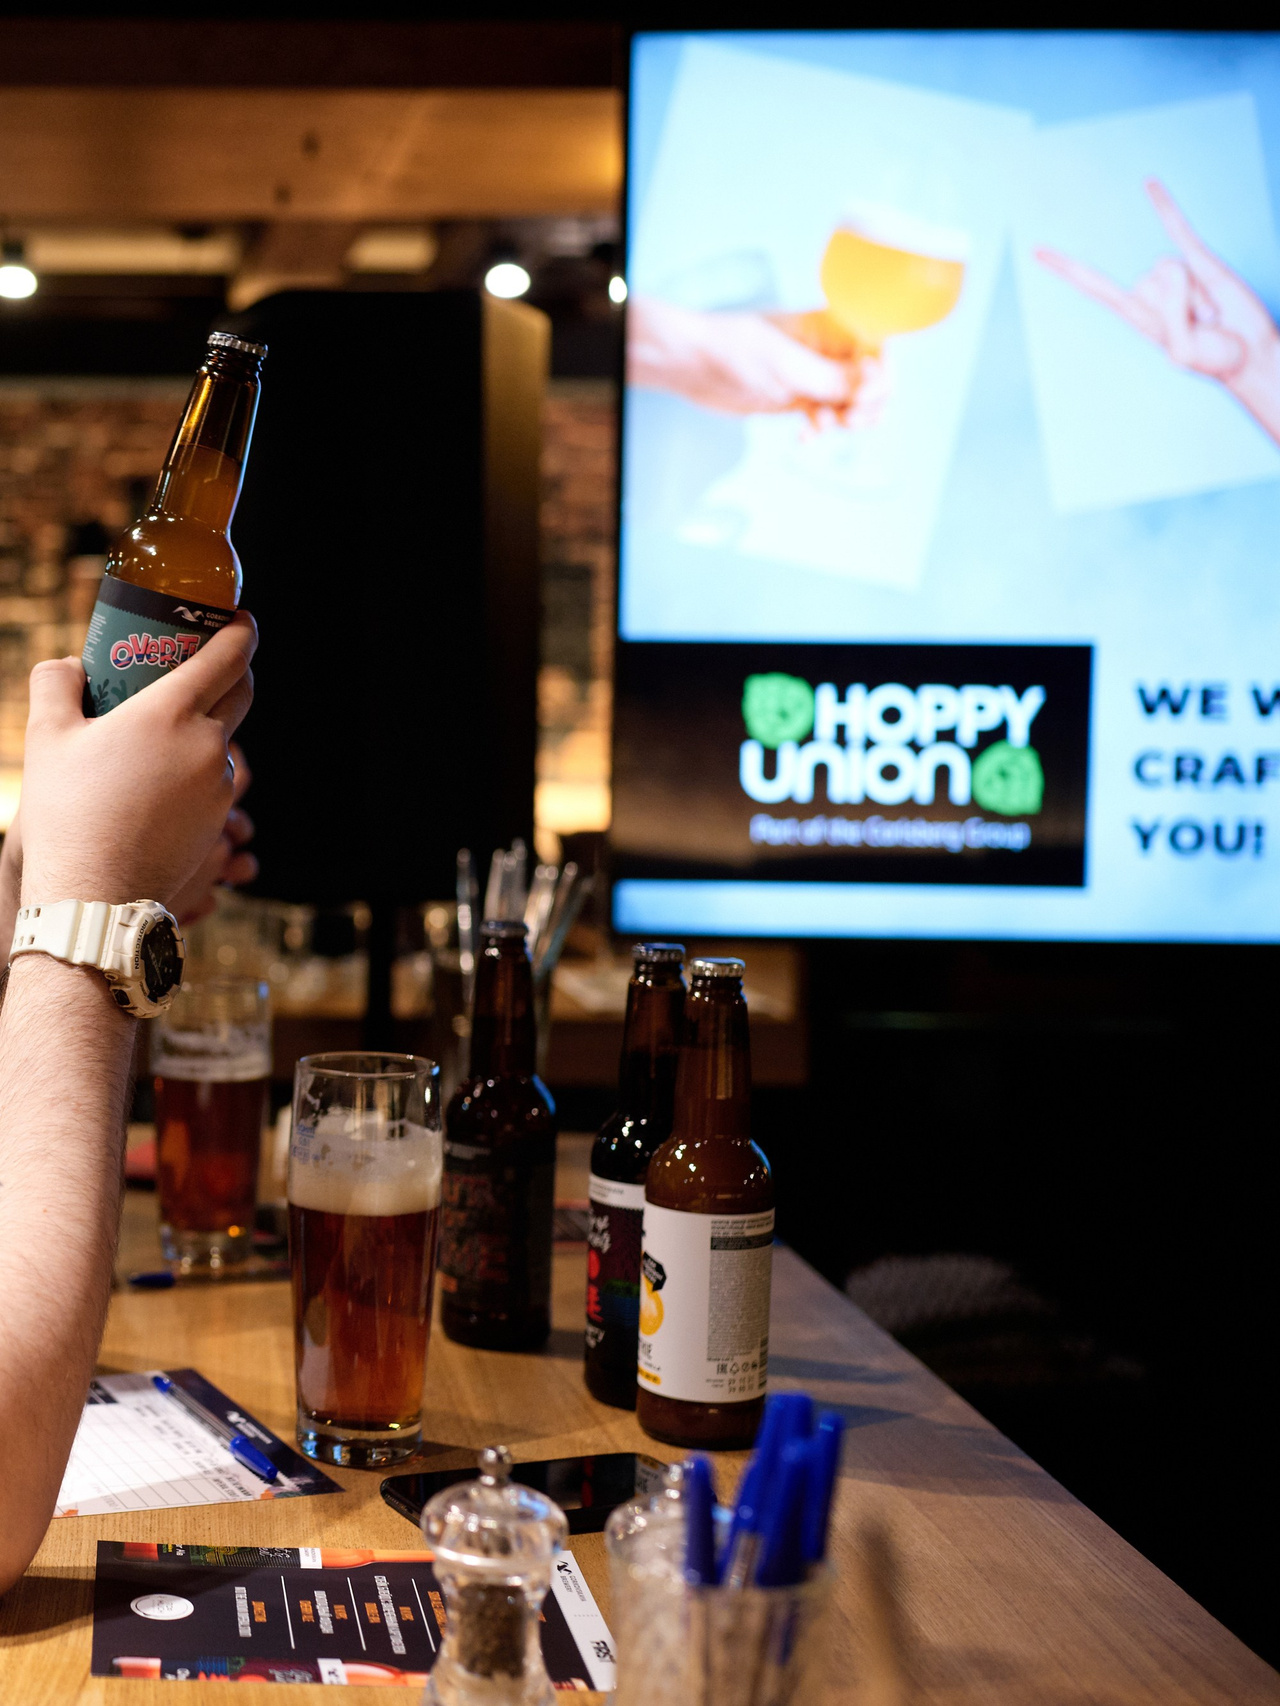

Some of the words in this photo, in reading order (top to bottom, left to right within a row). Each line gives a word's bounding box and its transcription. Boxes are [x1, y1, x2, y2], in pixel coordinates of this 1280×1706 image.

[815, 683, 1045, 747] HOPPY
[1135, 684, 1227, 719] WE
[1133, 820, 1263, 858] YOU!
[134, 919, 149, 970] PROTECTION
[560, 1576, 573, 1593] BREWERY
[569, 1576, 587, 1602] GORKOVSKAYA
